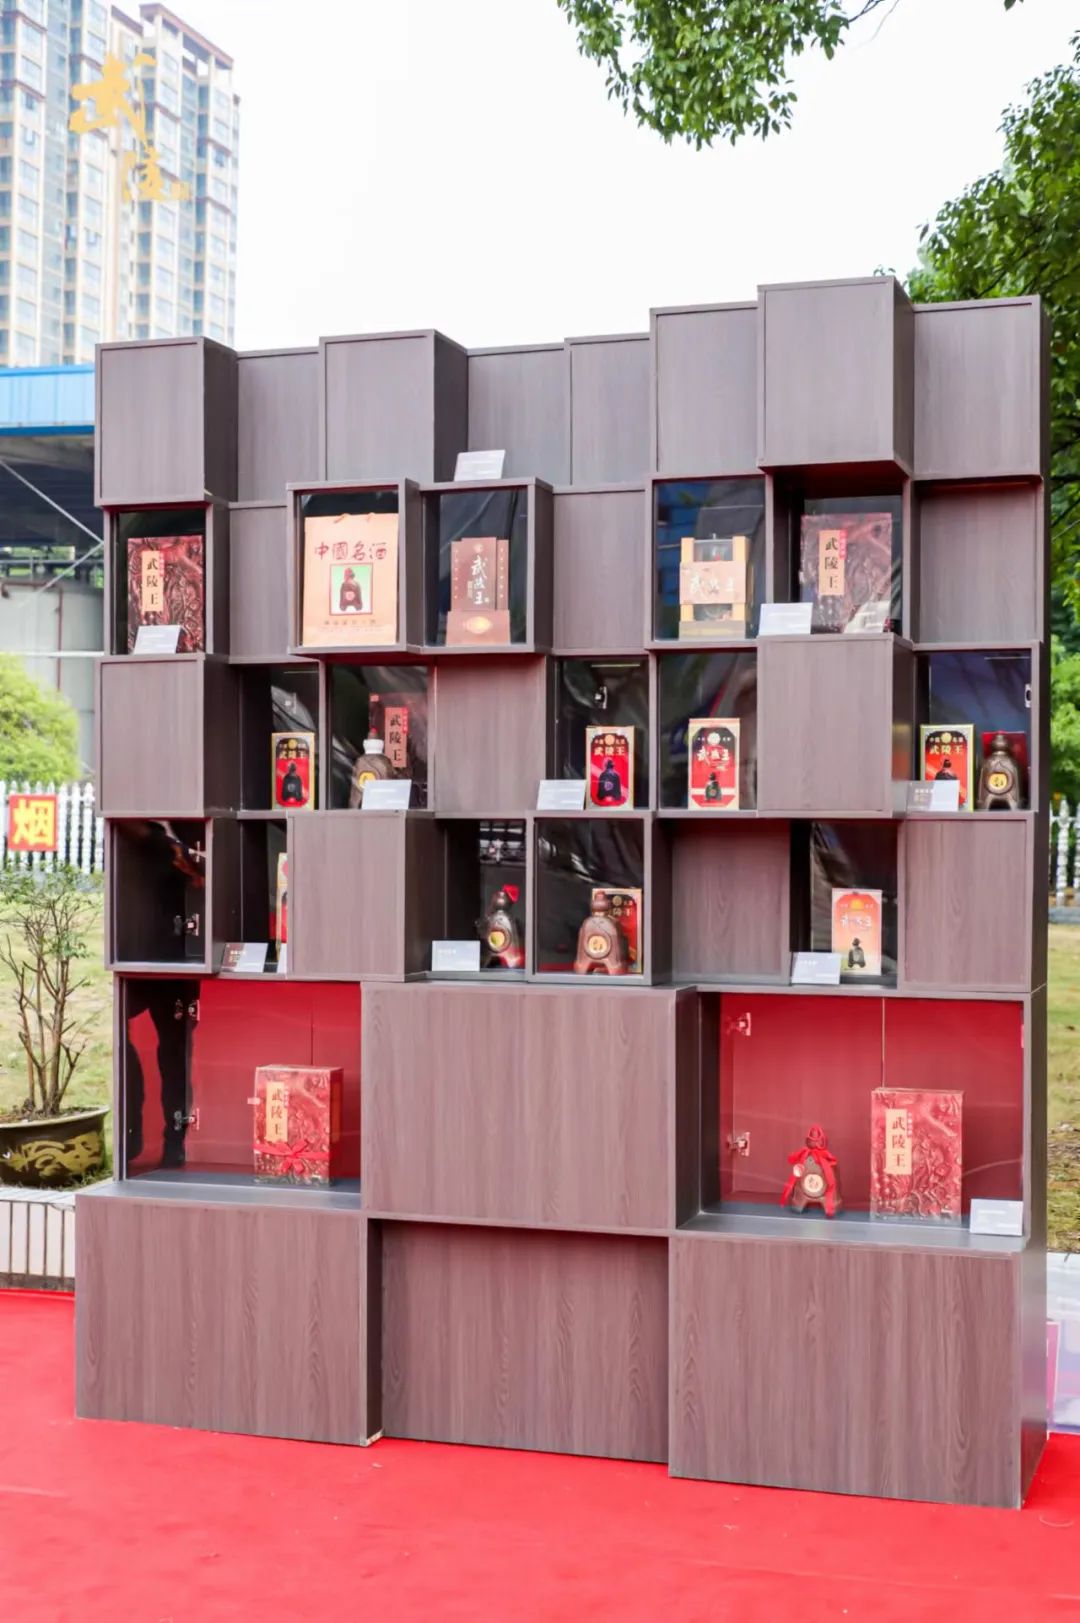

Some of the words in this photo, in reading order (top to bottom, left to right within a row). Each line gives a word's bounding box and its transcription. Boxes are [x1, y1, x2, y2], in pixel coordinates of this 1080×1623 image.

[146, 558, 159, 605] 武陵王
[824, 536, 839, 589] 武陵王
[388, 714, 403, 762] 武陵王
[928, 745, 964, 755] 武陵王
[13, 798, 54, 846] 烟
[892, 1116, 906, 1168] 武陵王
